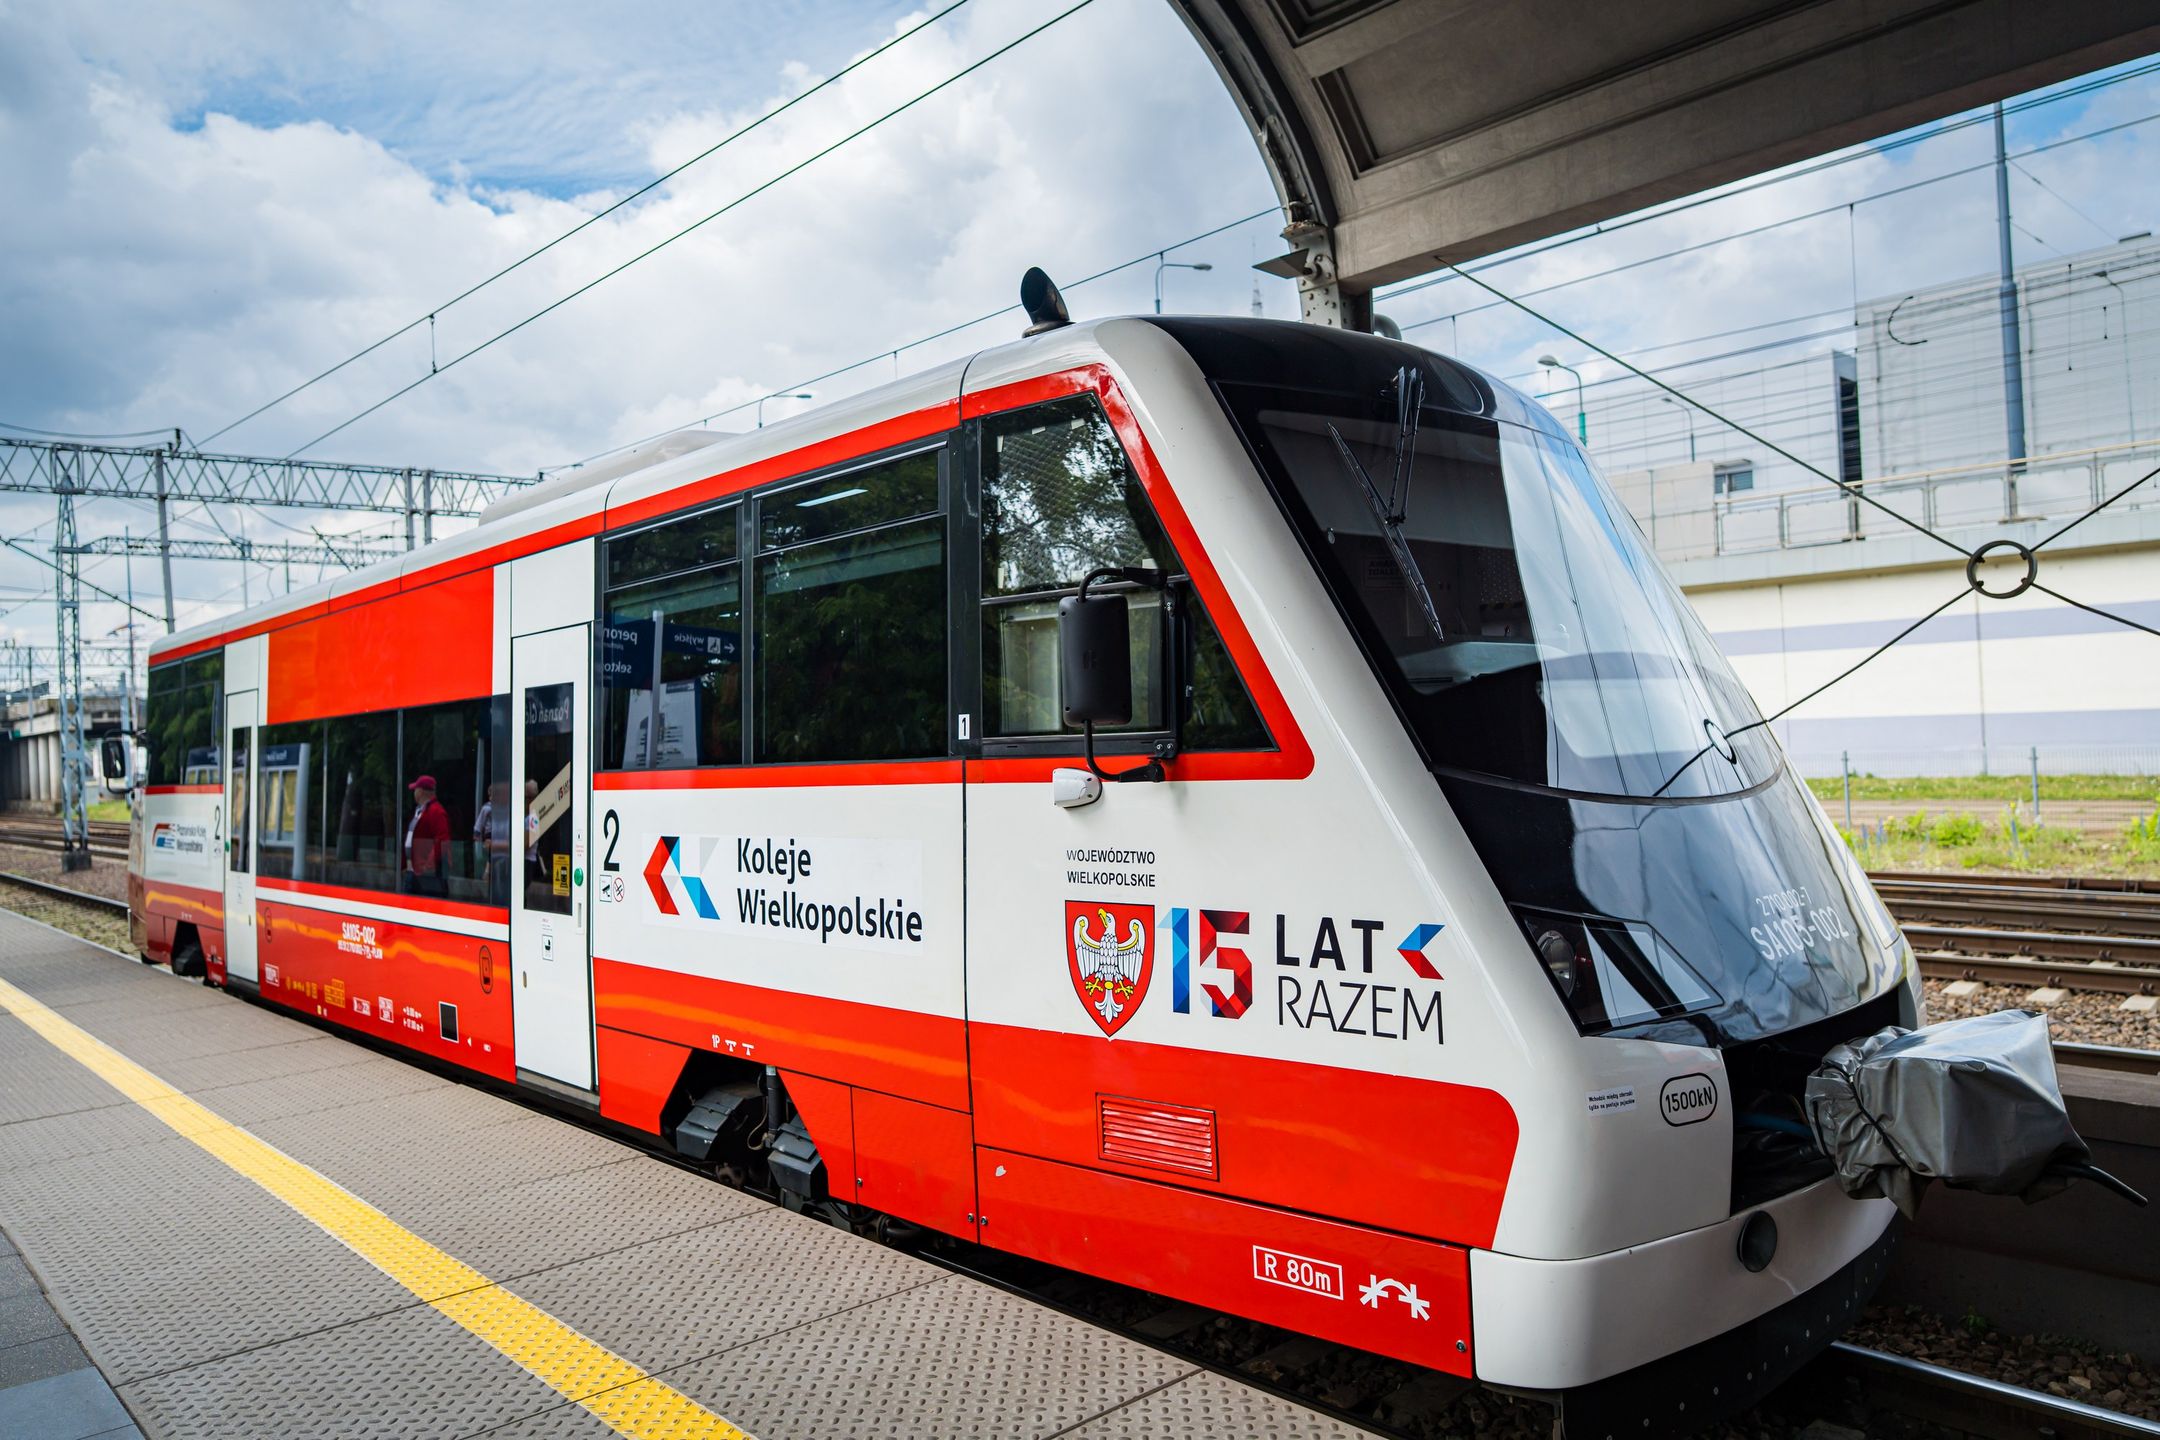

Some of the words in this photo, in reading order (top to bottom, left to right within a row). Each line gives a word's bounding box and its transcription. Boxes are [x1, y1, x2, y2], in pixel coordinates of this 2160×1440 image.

[961, 717, 967, 737] 1
[215, 805, 221, 840] 2
[603, 809, 620, 872] 2
[737, 838, 812, 885] Koleje
[1066, 847, 1155, 865] WOJEWÓDZTWO
[1066, 871, 1156, 888] WIELKOPOLSKIE
[737, 888, 923, 944] Wielkopolskie
[1750, 906, 1850, 961] SA105-002
[1157, 907, 1253, 1020] 15
[1276, 914, 1384, 973] LAT
[1278, 975, 1445, 1045] RAZEM
[1665, 1086, 1713, 1113] 1500kN
[1264, 1253, 1278, 1279] R
[1287, 1259, 1331, 1292] 80m
